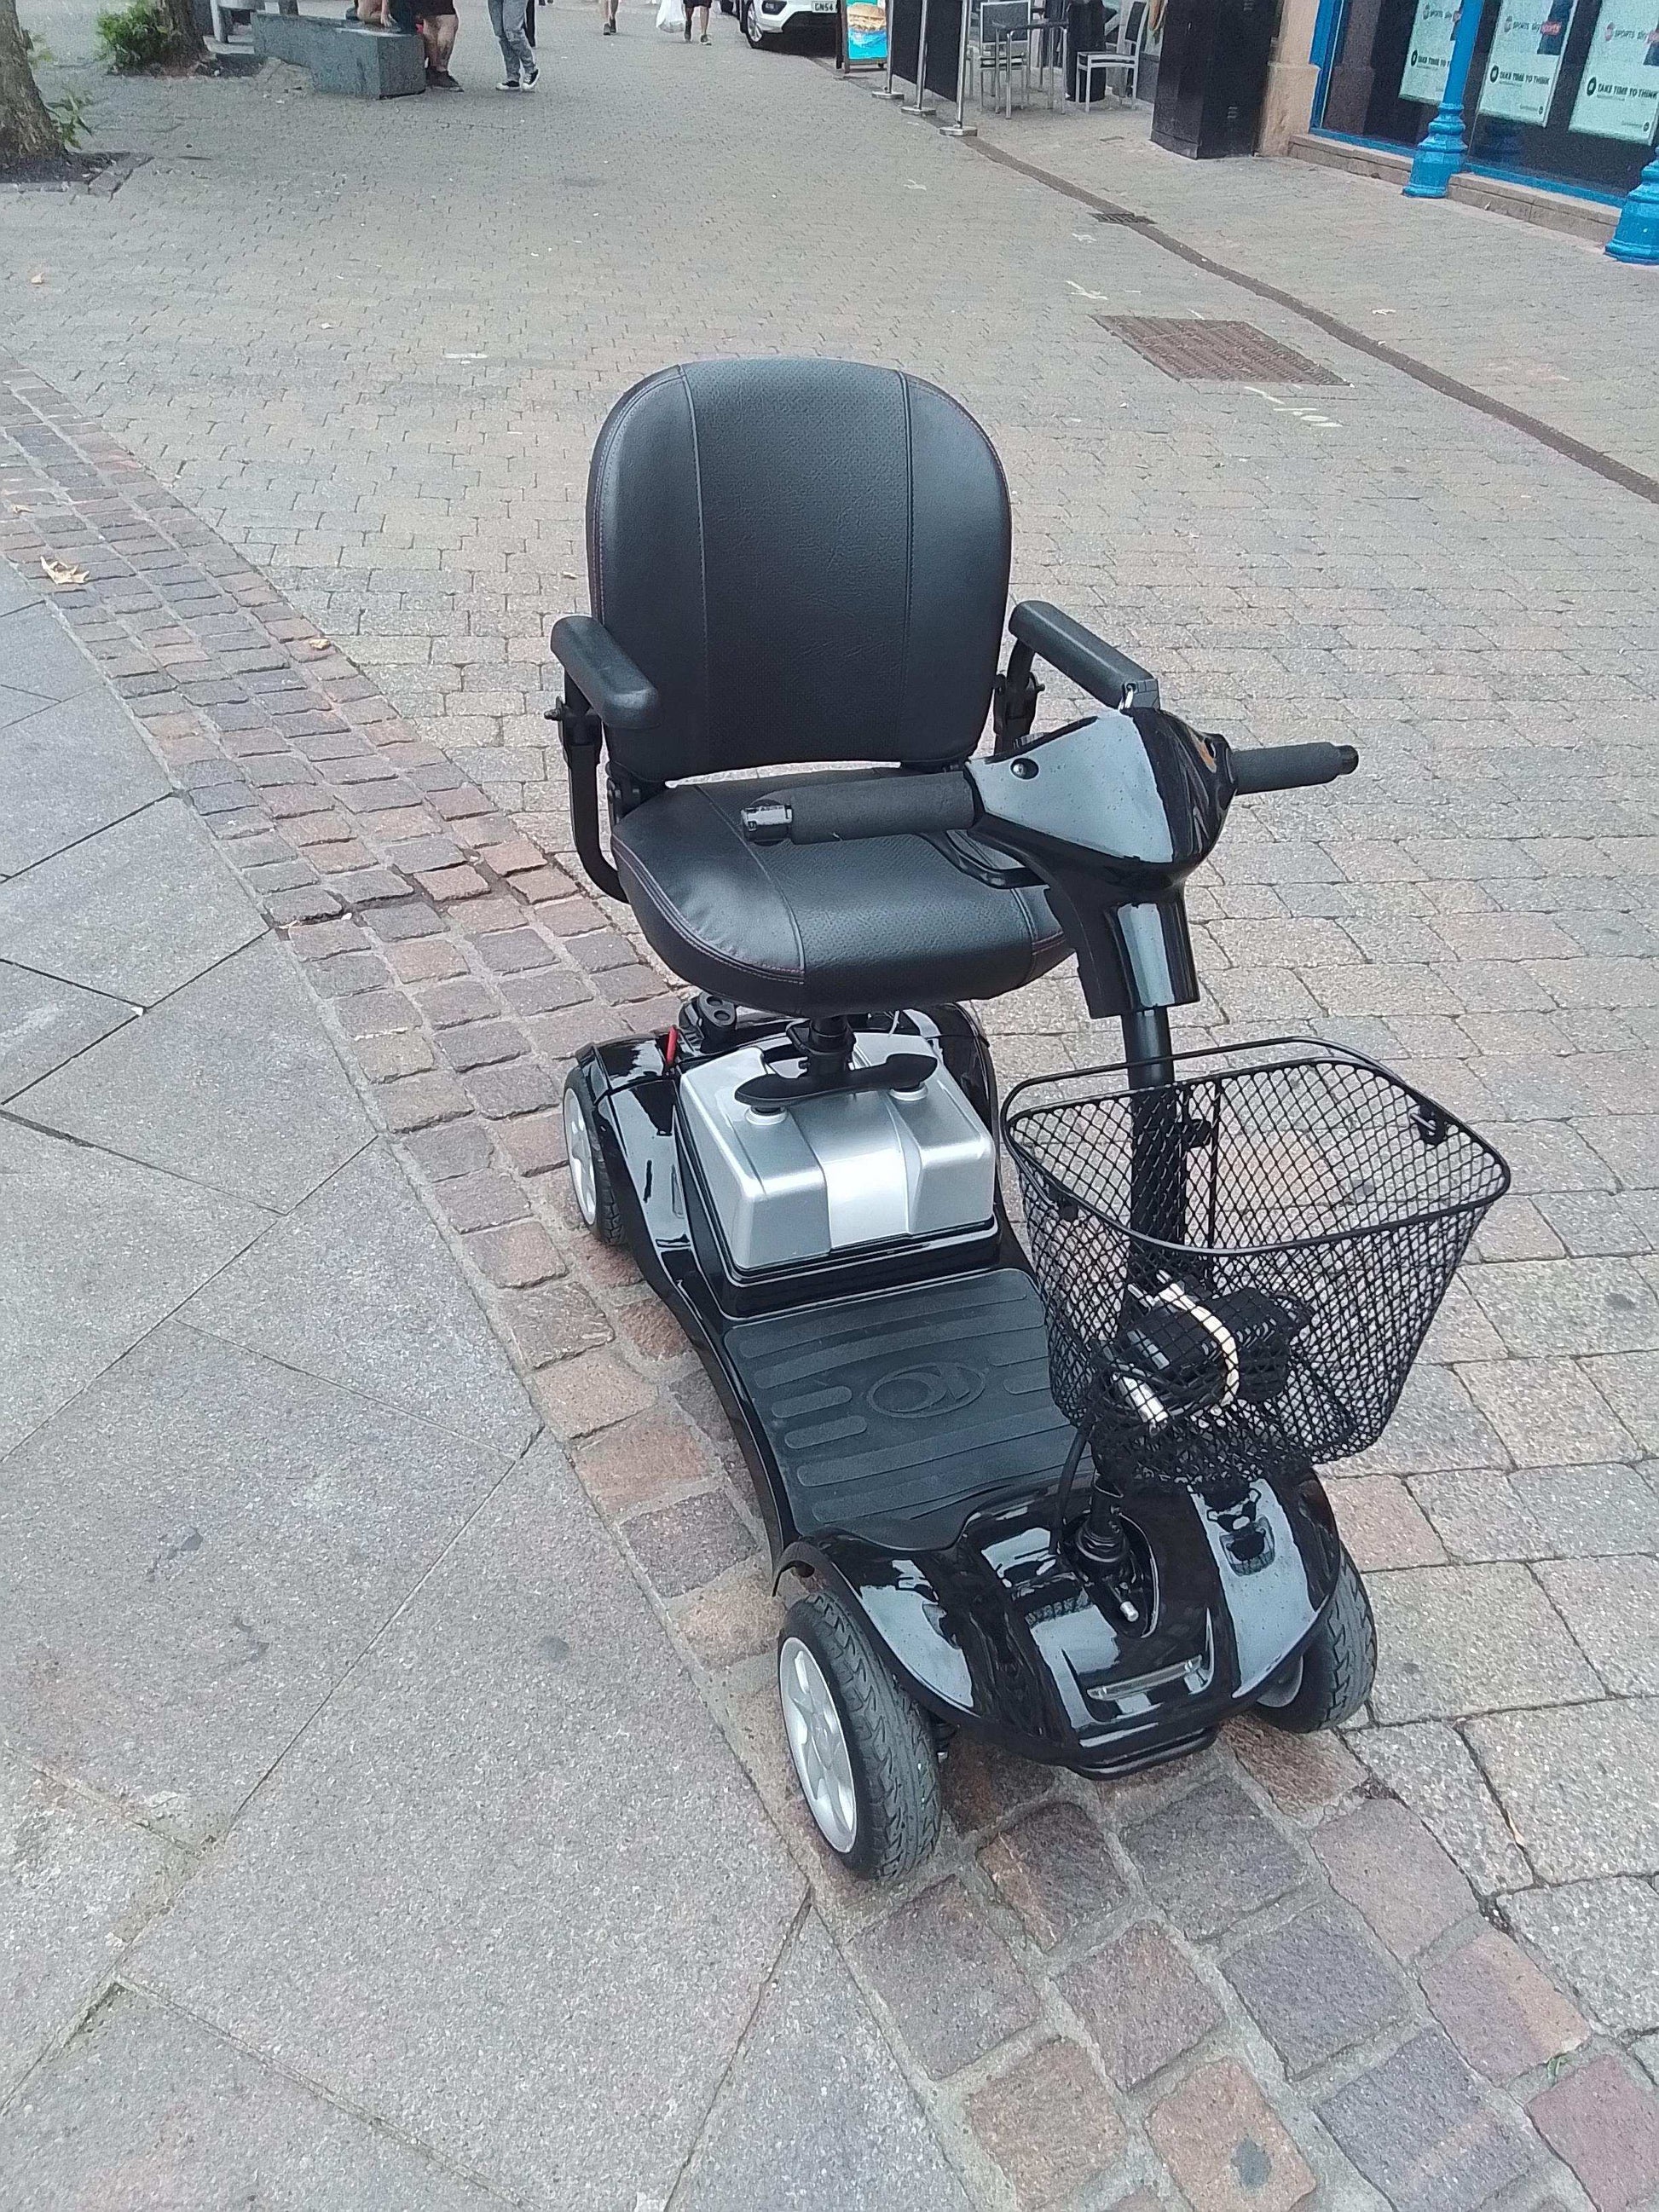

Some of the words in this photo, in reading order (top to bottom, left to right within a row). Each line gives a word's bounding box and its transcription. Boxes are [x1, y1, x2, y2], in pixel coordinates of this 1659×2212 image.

[1500, 71, 1512, 80] TAKE
[1512, 72, 1525, 82] TIME
[1525, 75, 1533, 84] TO
[1534, 75, 1550, 85] THINK
[1598, 83, 1612, 93] TAKE
[1613, 85, 1628, 95] TIME
[1629, 88, 1638, 97] TO
[1638, 89, 1658, 100] THINK
